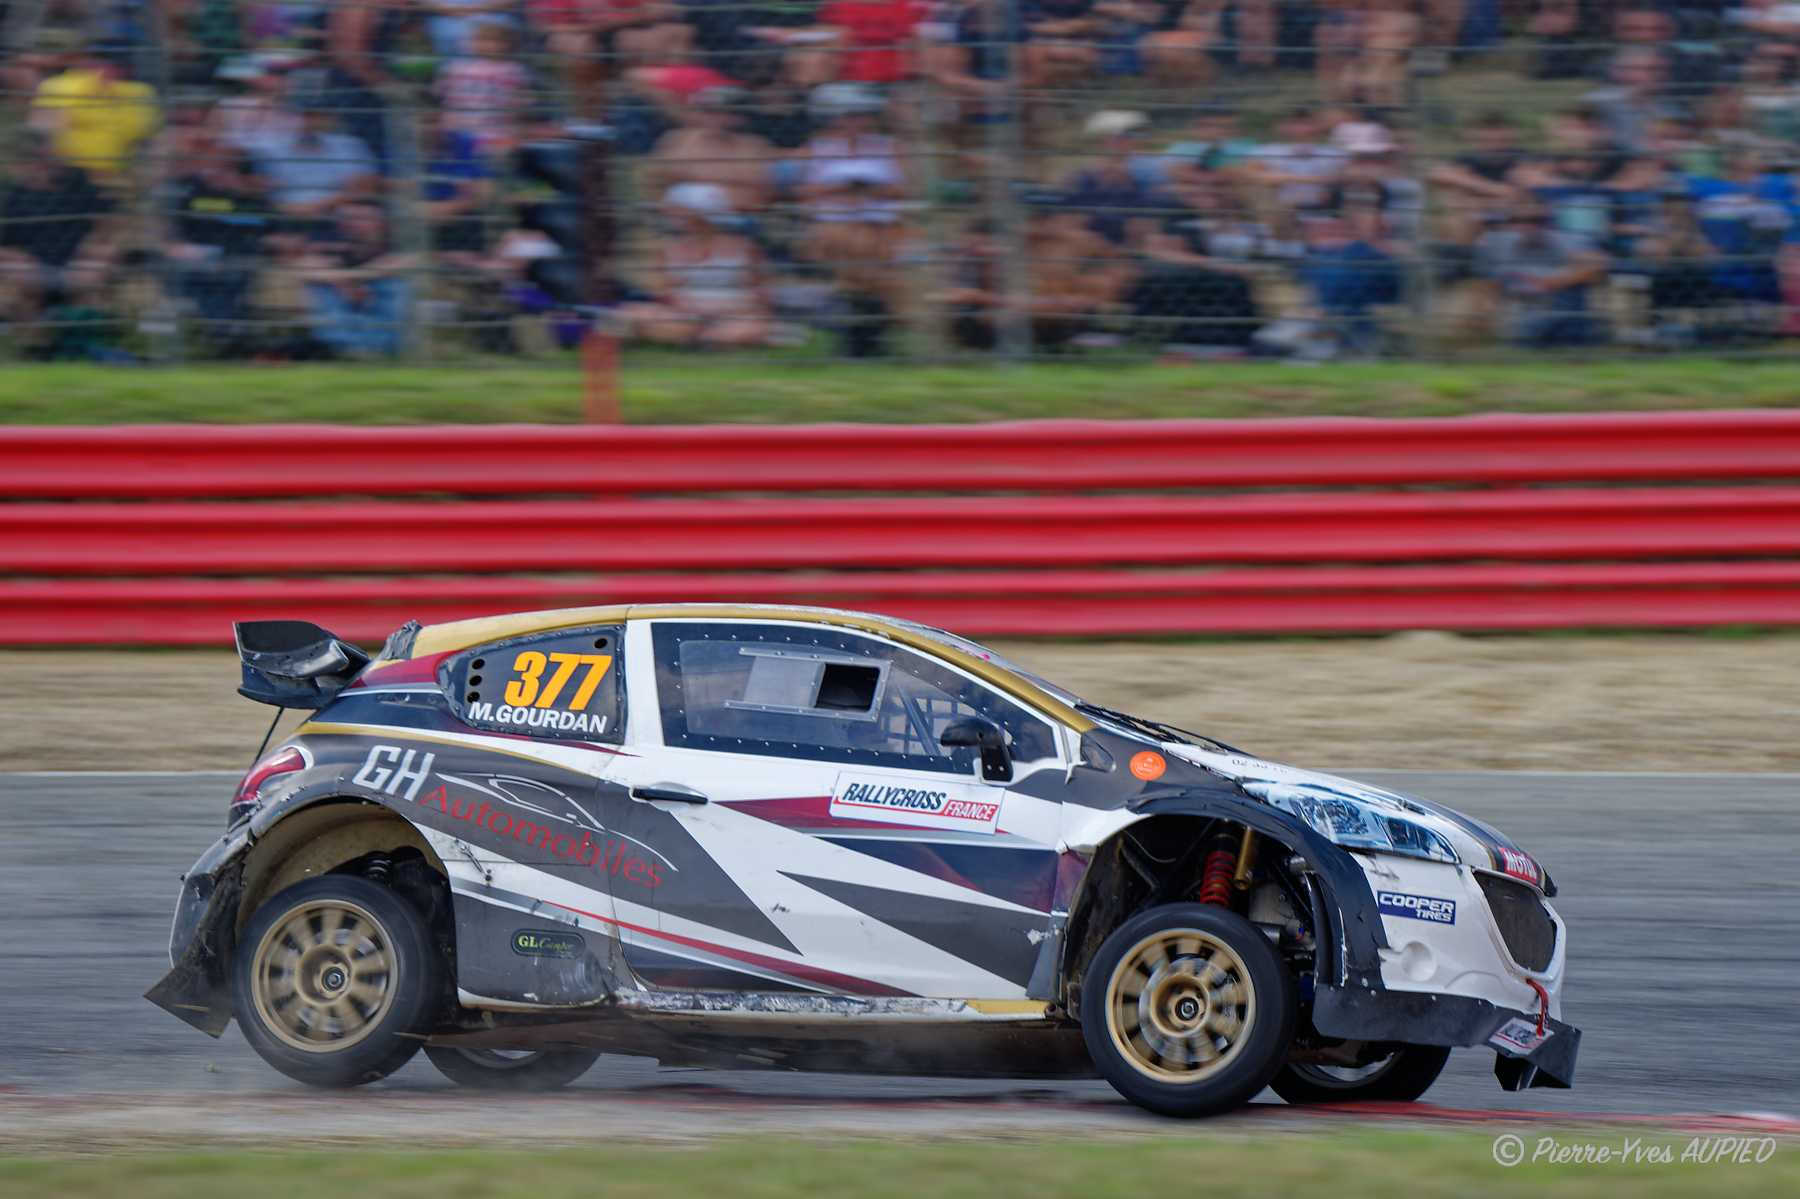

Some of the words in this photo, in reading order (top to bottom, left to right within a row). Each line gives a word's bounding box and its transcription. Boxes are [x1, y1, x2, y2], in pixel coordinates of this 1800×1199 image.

[504, 650, 613, 711] 377
[468, 701, 608, 734] M.GOURDAN
[352, 745, 435, 801] GH
[843, 782, 947, 811] RALLYCROSS
[944, 800, 997, 821] FRANCE
[419, 784, 667, 889] Automobiles
[1379, 893, 1455, 914] COOPER
[1415, 908, 1454, 922] TIRES
